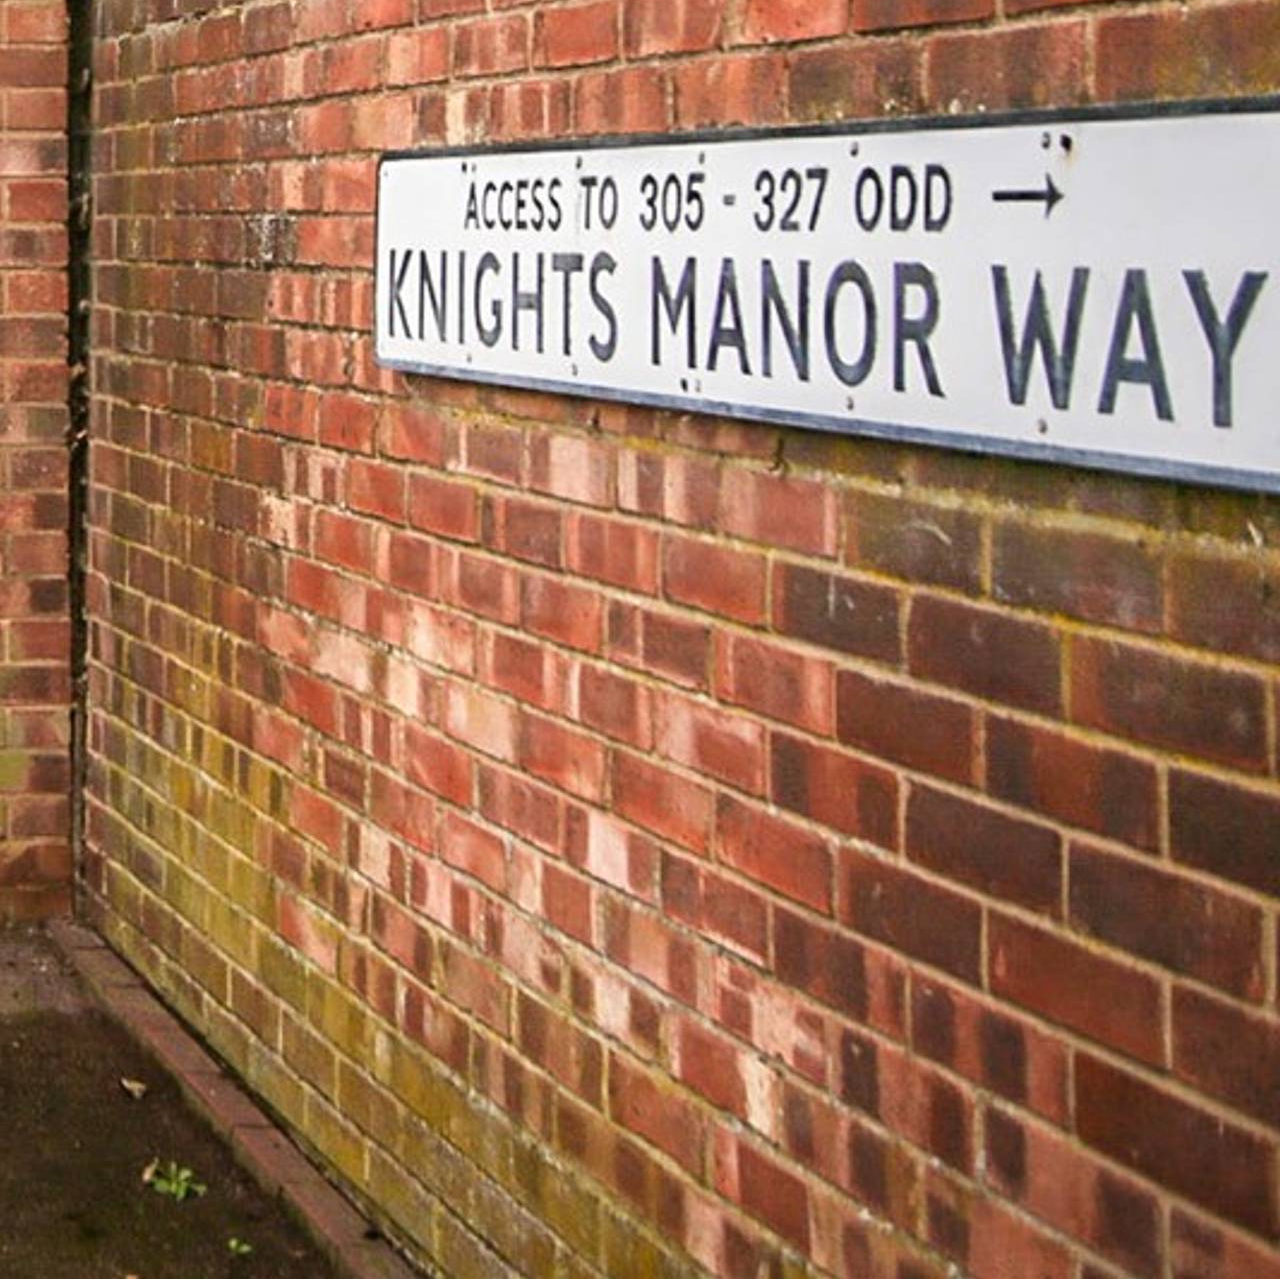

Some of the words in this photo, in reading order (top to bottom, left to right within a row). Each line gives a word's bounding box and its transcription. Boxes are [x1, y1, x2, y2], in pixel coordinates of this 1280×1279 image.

[464, 168, 563, 232] ACCESS
[581, 164, 619, 227] TO
[639, 173, 705, 233] 305
[752, 167, 829, 233] 327
[854, 164, 953, 233] ODD
[387, 248, 619, 364] KNIGHTS
[650, 255, 946, 399] MANOR
[991, 264, 1269, 429] WAY
